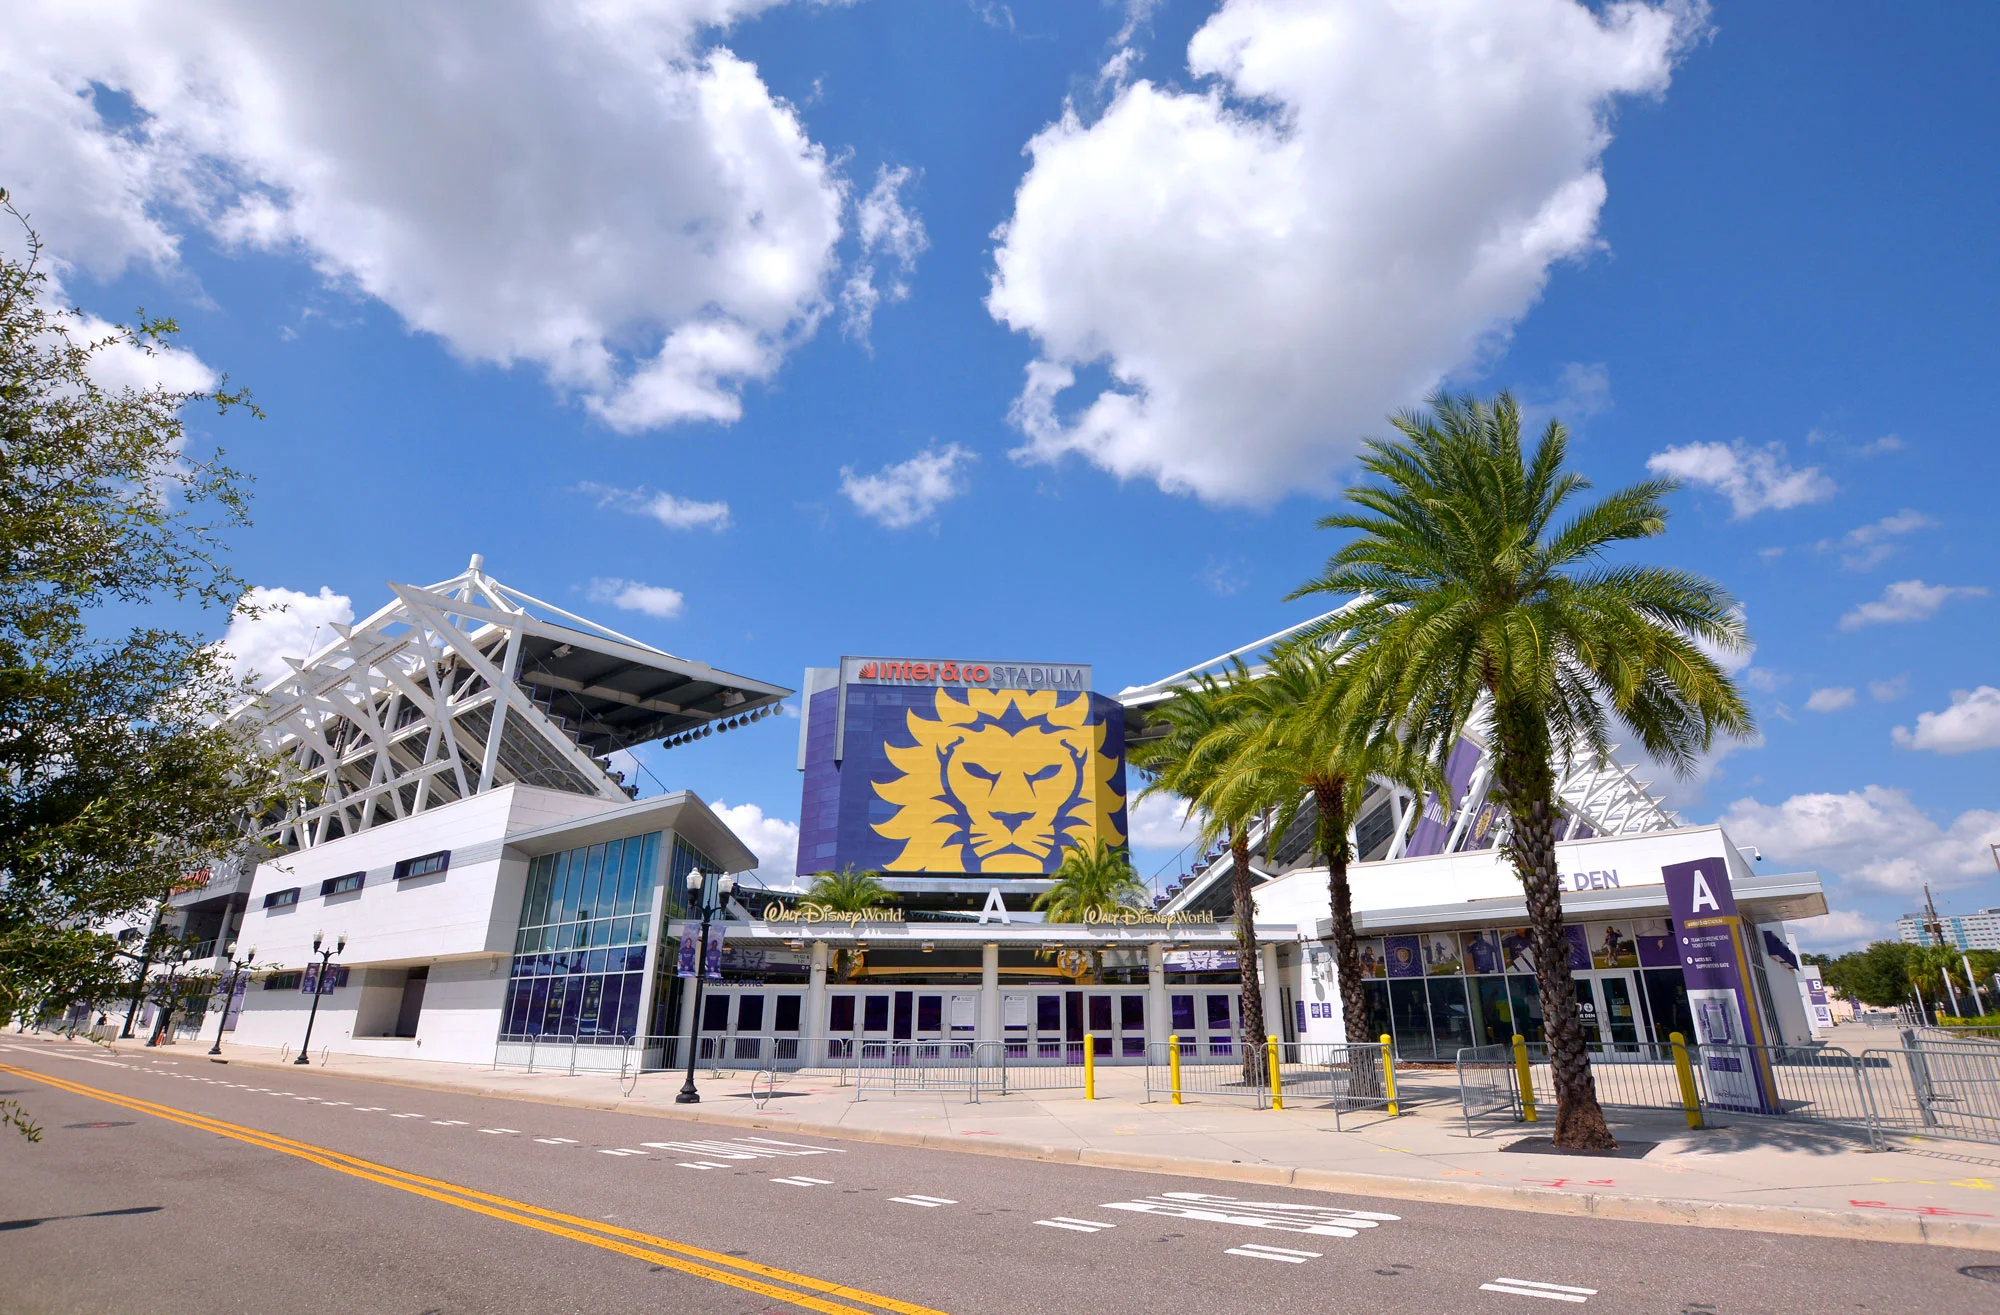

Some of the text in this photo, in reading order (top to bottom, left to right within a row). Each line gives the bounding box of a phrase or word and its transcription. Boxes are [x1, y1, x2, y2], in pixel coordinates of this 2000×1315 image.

[880, 661, 1082, 685] inter&co STADIUM
[1573, 869, 1620, 891] DEN
[1693, 869, 1720, 913] A
[979, 887, 1011, 926] A
[1812, 980, 1822, 990] B
